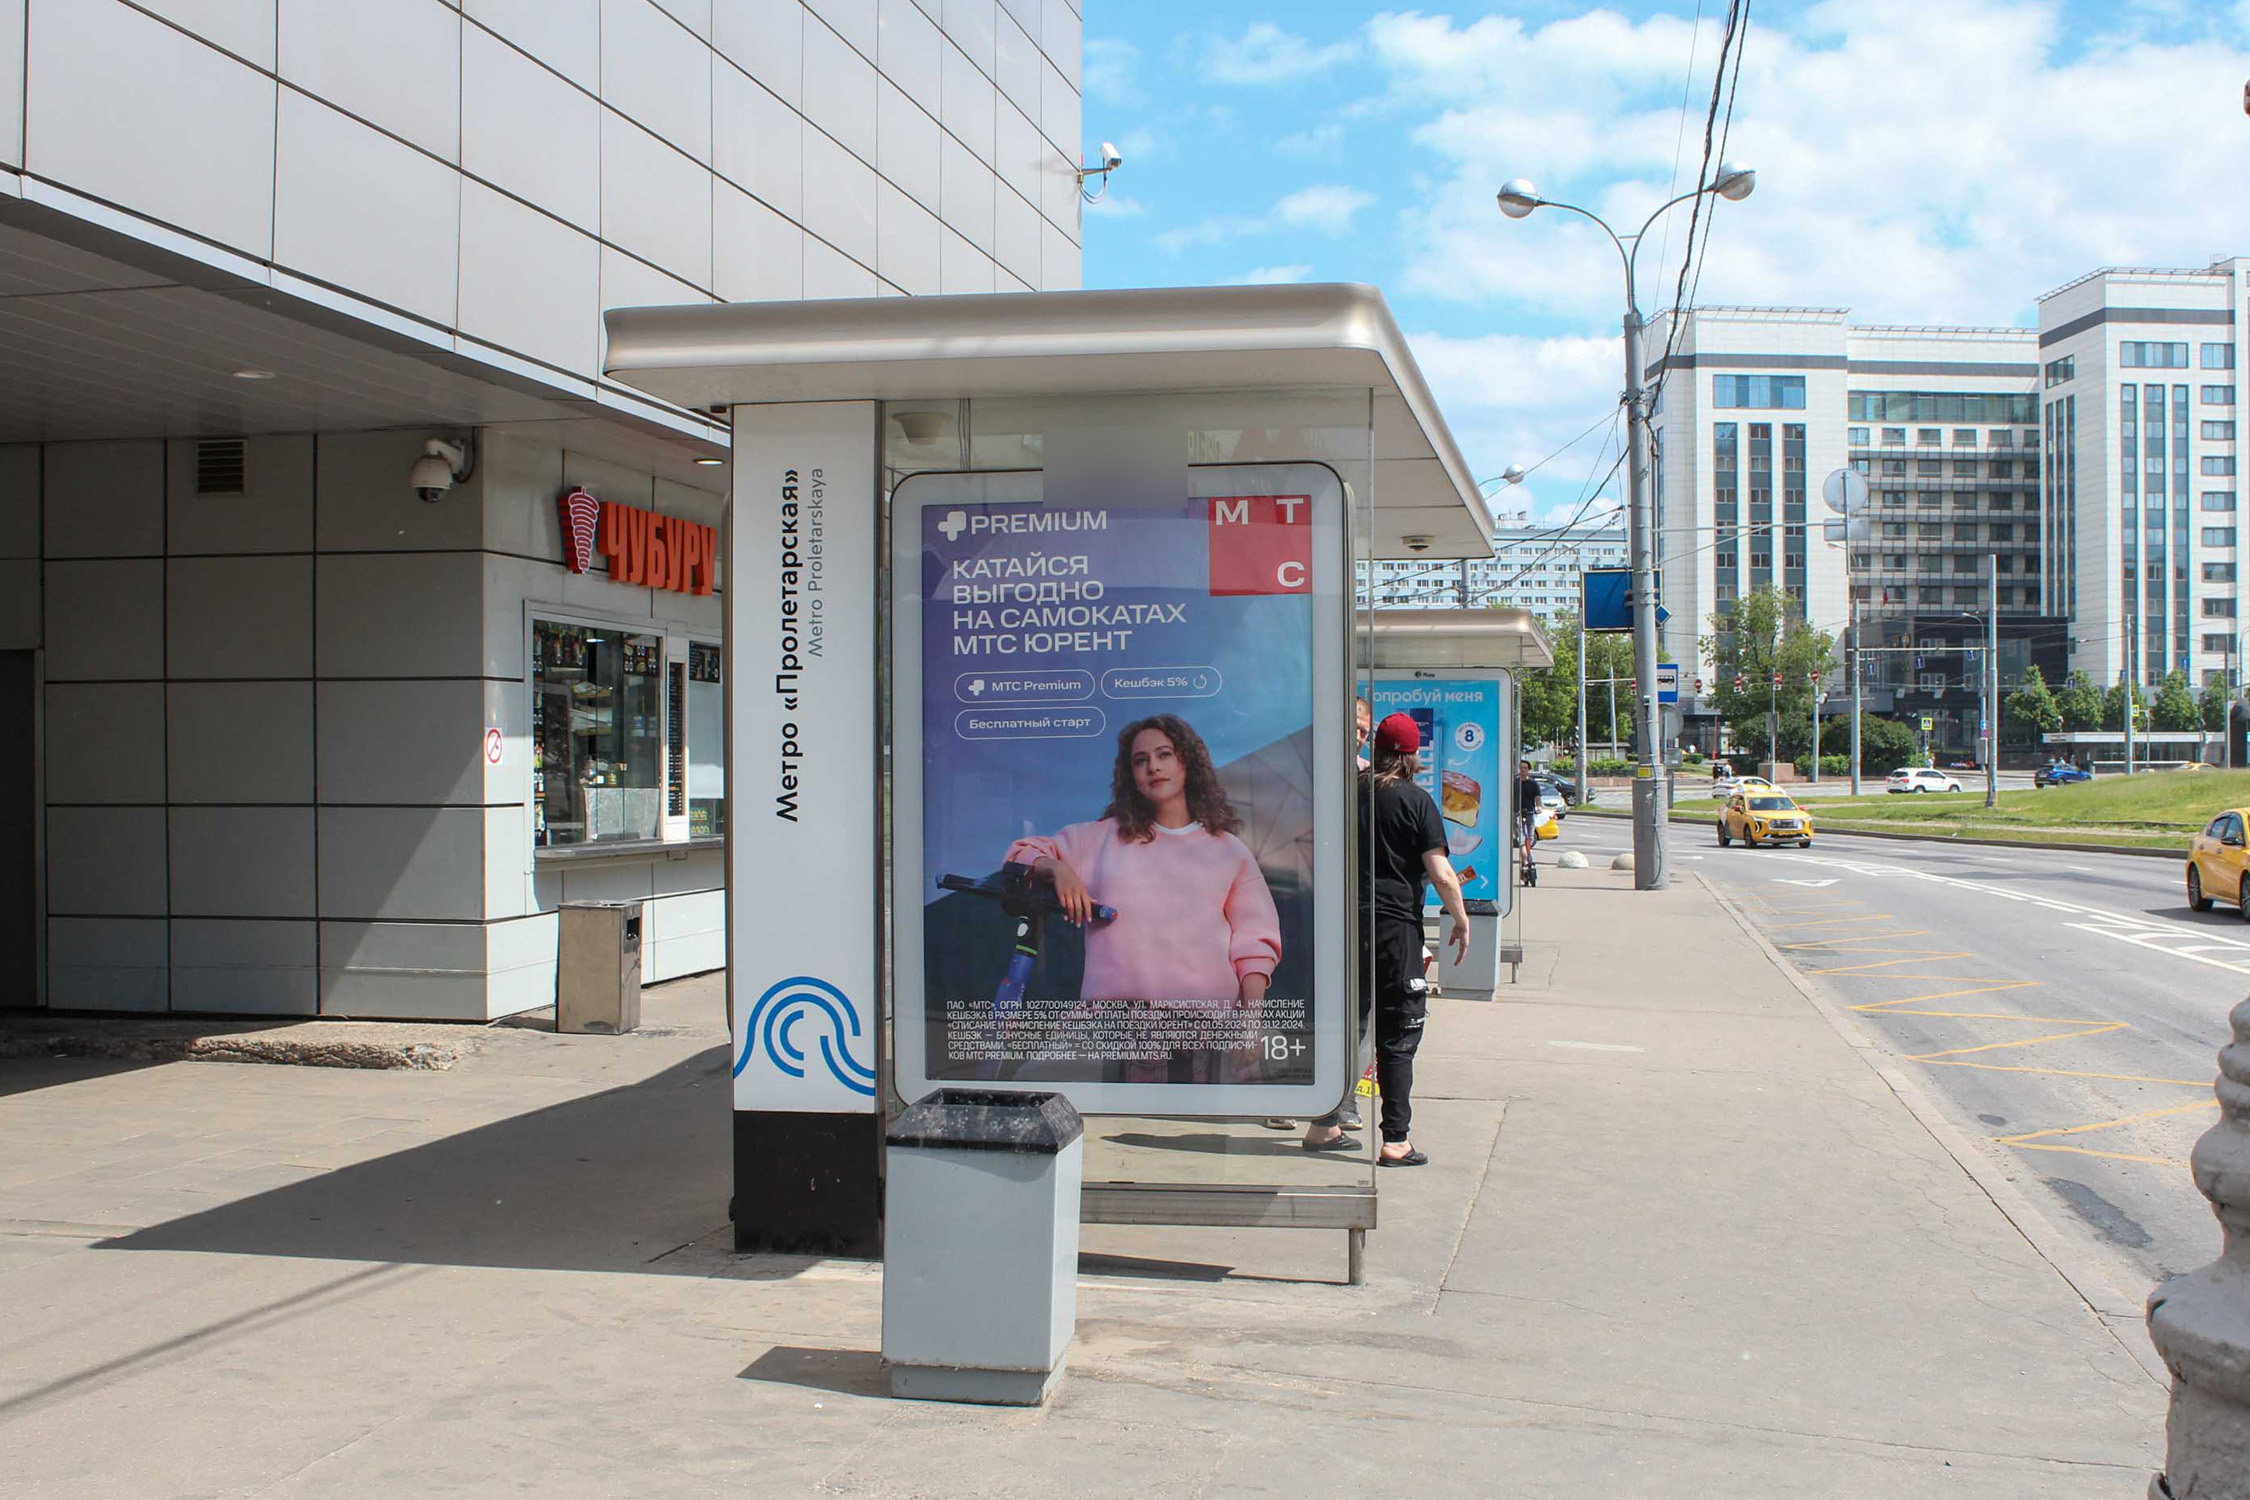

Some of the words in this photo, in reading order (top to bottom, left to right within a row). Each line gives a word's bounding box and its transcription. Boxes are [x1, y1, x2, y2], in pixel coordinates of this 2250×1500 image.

[807, 468, 827, 592] Proletarskaya
[971, 510, 1107, 535] PREMIUM
[597, 501, 717, 596] ЧУБУРУ
[953, 551, 1088, 580] КАТАЙСЯ
[776, 468, 803, 711] «Пролетарская»
[953, 580, 1104, 606] ВЫГОДНО
[953, 609, 995, 630] НА
[1000, 603, 1187, 629] САМОКАТАХ
[807, 599, 823, 657] Metro
[953, 633, 1017, 655] МТС
[1024, 630, 1133, 653] ЮРЕНТ
[991, 681, 1021, 692] МТС
[1024, 679, 1082, 692] Premium
[1114, 678, 1164, 689] Кешбэк
[1167, 676, 1188, 688] 5%
[1445, 691, 1484, 702] меня
[969, 717, 1051, 730] Бесплатный
[1053, 718, 1091, 730] старт
[1465, 729, 1474, 742] 8
[776, 722, 803, 822] Метро
[946, 1001, 965, 1010] ПАО
[1001, 1001, 1022, 1010] ОГРН
[1133, 1000, 1146, 1009] УЛ.
[1248, 999, 1305, 1009] НАЧИСЛЕНИЕ
[946, 1010, 986, 1021] КЕШБЭКА
[988, 1010, 994, 1020] В
[995, 1010, 1032, 1020] РАЗМЕРЕ
[1034, 1010, 1048, 1020] 5%
[1049, 1010, 1059, 1020] ОТ
[1060, 1010, 1093, 1020] СУММЫ
[1094, 1010, 1129, 1020] ОПЛАТЫ
[1131, 1010, 1172, 1020] ПОЕЗДКИ
[1173, 1010, 1231, 1020] ПРОИСХОДИТ
[1232, 1010, 1238, 1019] В
[1239, 1010, 1274, 1019] РАМКАХ
[1275, 1010, 1305, 1020] АКЦИИ
[947, 1020, 997, 1030] «СПИСАНИЕ
[998, 1020, 1005, 1030] И
[1006, 1020, 1060, 1030] НАЧИСЛЕНИЕ
[1062, 1020, 1103, 1030] КЕШБЭКА
[1104, 1020, 1115, 1030] НА
[1117, 1020, 1158, 1031] ПОЕЗДКИ
[1158, 1020, 1192, 1030] ЮРЕНТ»
[1193, 1020, 1200, 1030] С
[1248, 1020, 1260, 1029] ПО
[947, 1031, 982, 1040] КЕШБЭК
[996, 1030, 1042, 1040] БОНУСНЫЕ
[1092, 1030, 1132, 1040] КОТОРЫЕ
[1136, 1030, 1147, 1040] НЕ
[1150, 1030, 1197, 1040] ЯВЛЯЮТСЯ
[1200, 1030, 1258, 1040] ДЕНЕЖНЫМИ
[1007, 1039, 1073, 1050] «БЕСПЛАТНЫЙ»
[1081, 1041, 1094, 1050] СО
[1095, 1039, 1137, 1051] СКИДКОЙ
[1138, 1040, 1161, 1050] 100%
[1162, 1041, 1180, 1051] ДЛЯ
[1182, 1041, 1204, 1050] ВСЕХ
[1206, 1040, 1259, 1051] ПОДПИСЧИ-
[1260, 1035, 1306, 1060] 18+
[948, 1051, 965, 1060] КОВ
[966, 1051, 984, 1060] МТС
[1027, 1051, 1077, 1061] ПОДРОБНЕЕ
[1088, 1051, 1099, 1060] НА
